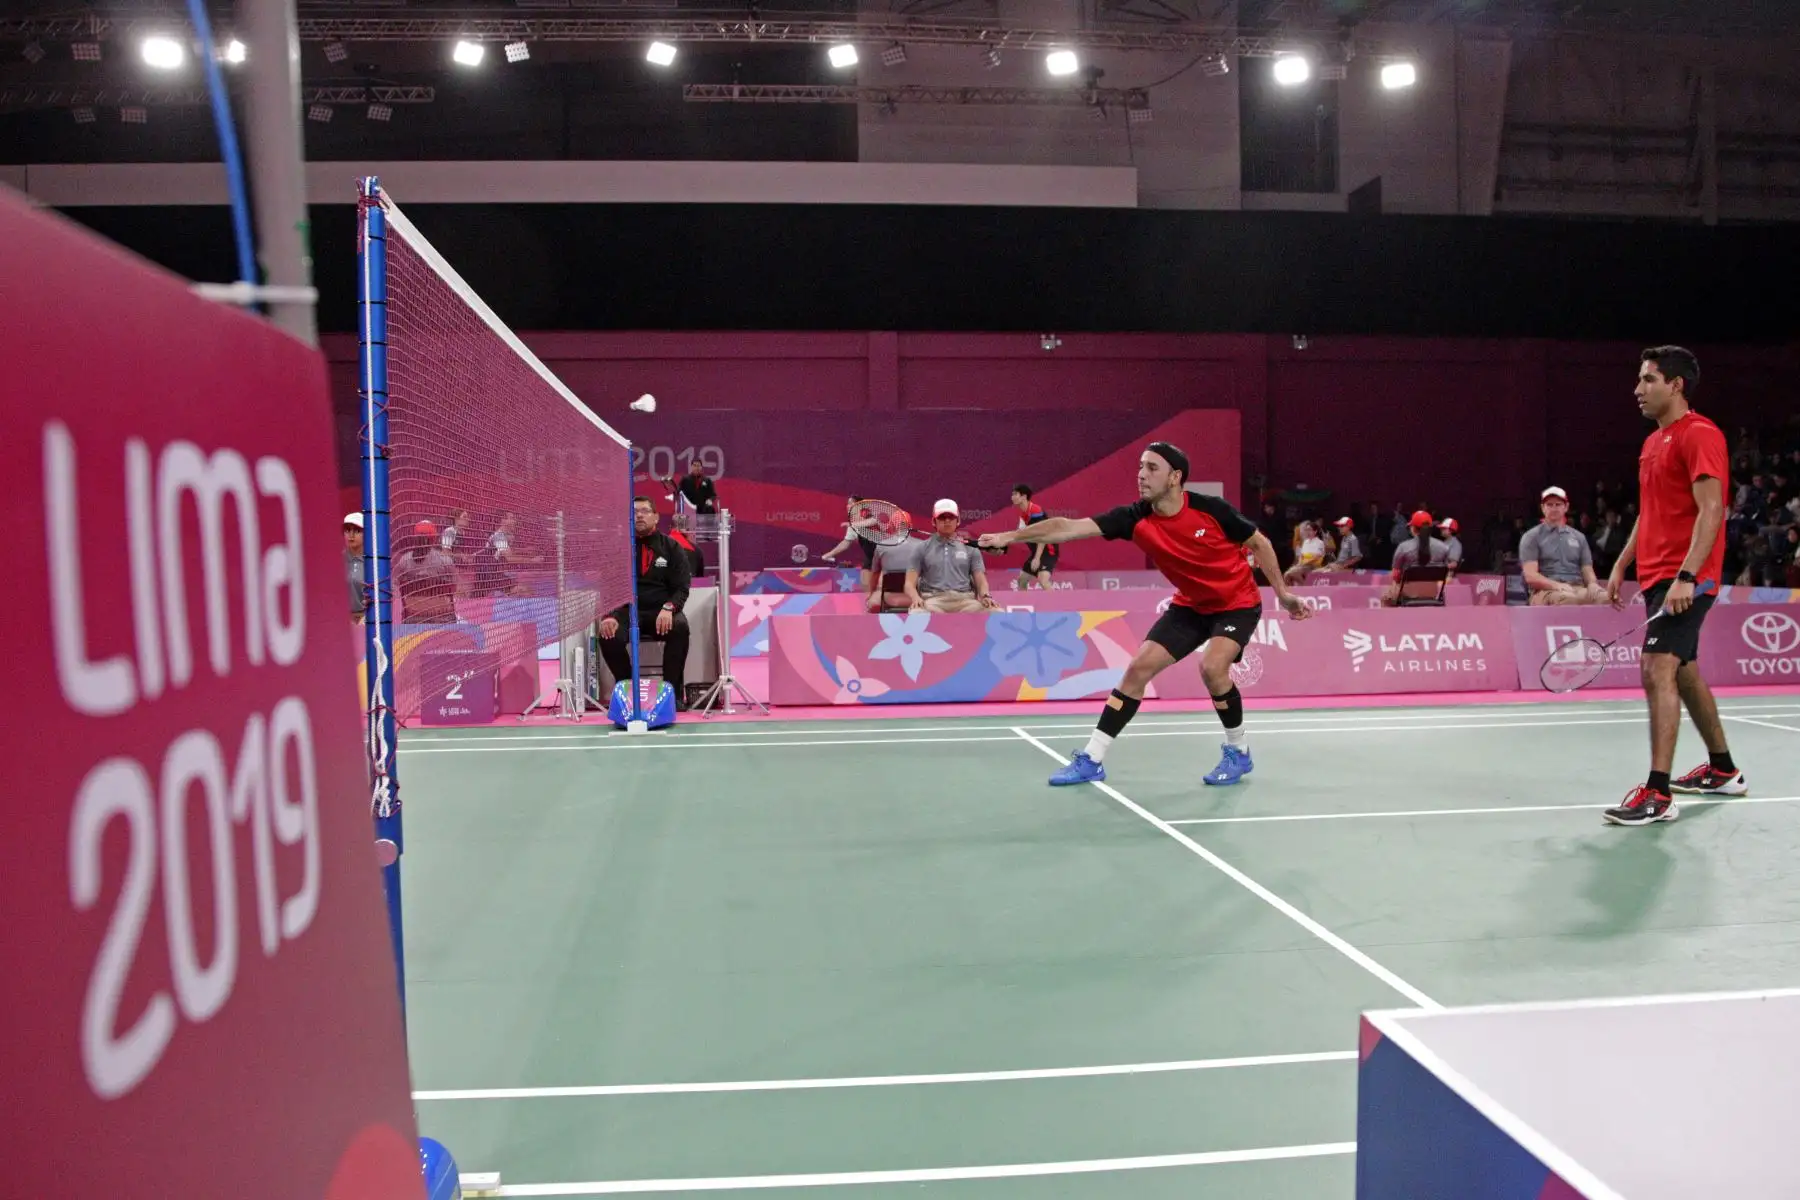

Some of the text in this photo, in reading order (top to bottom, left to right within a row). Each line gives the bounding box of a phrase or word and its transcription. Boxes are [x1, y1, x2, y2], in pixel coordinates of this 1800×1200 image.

[631, 445, 725, 482] 2019
[1379, 633, 1484, 652] LATAM
[1384, 659, 1487, 673] AIRLINES
[68, 695, 321, 1099] 2019
